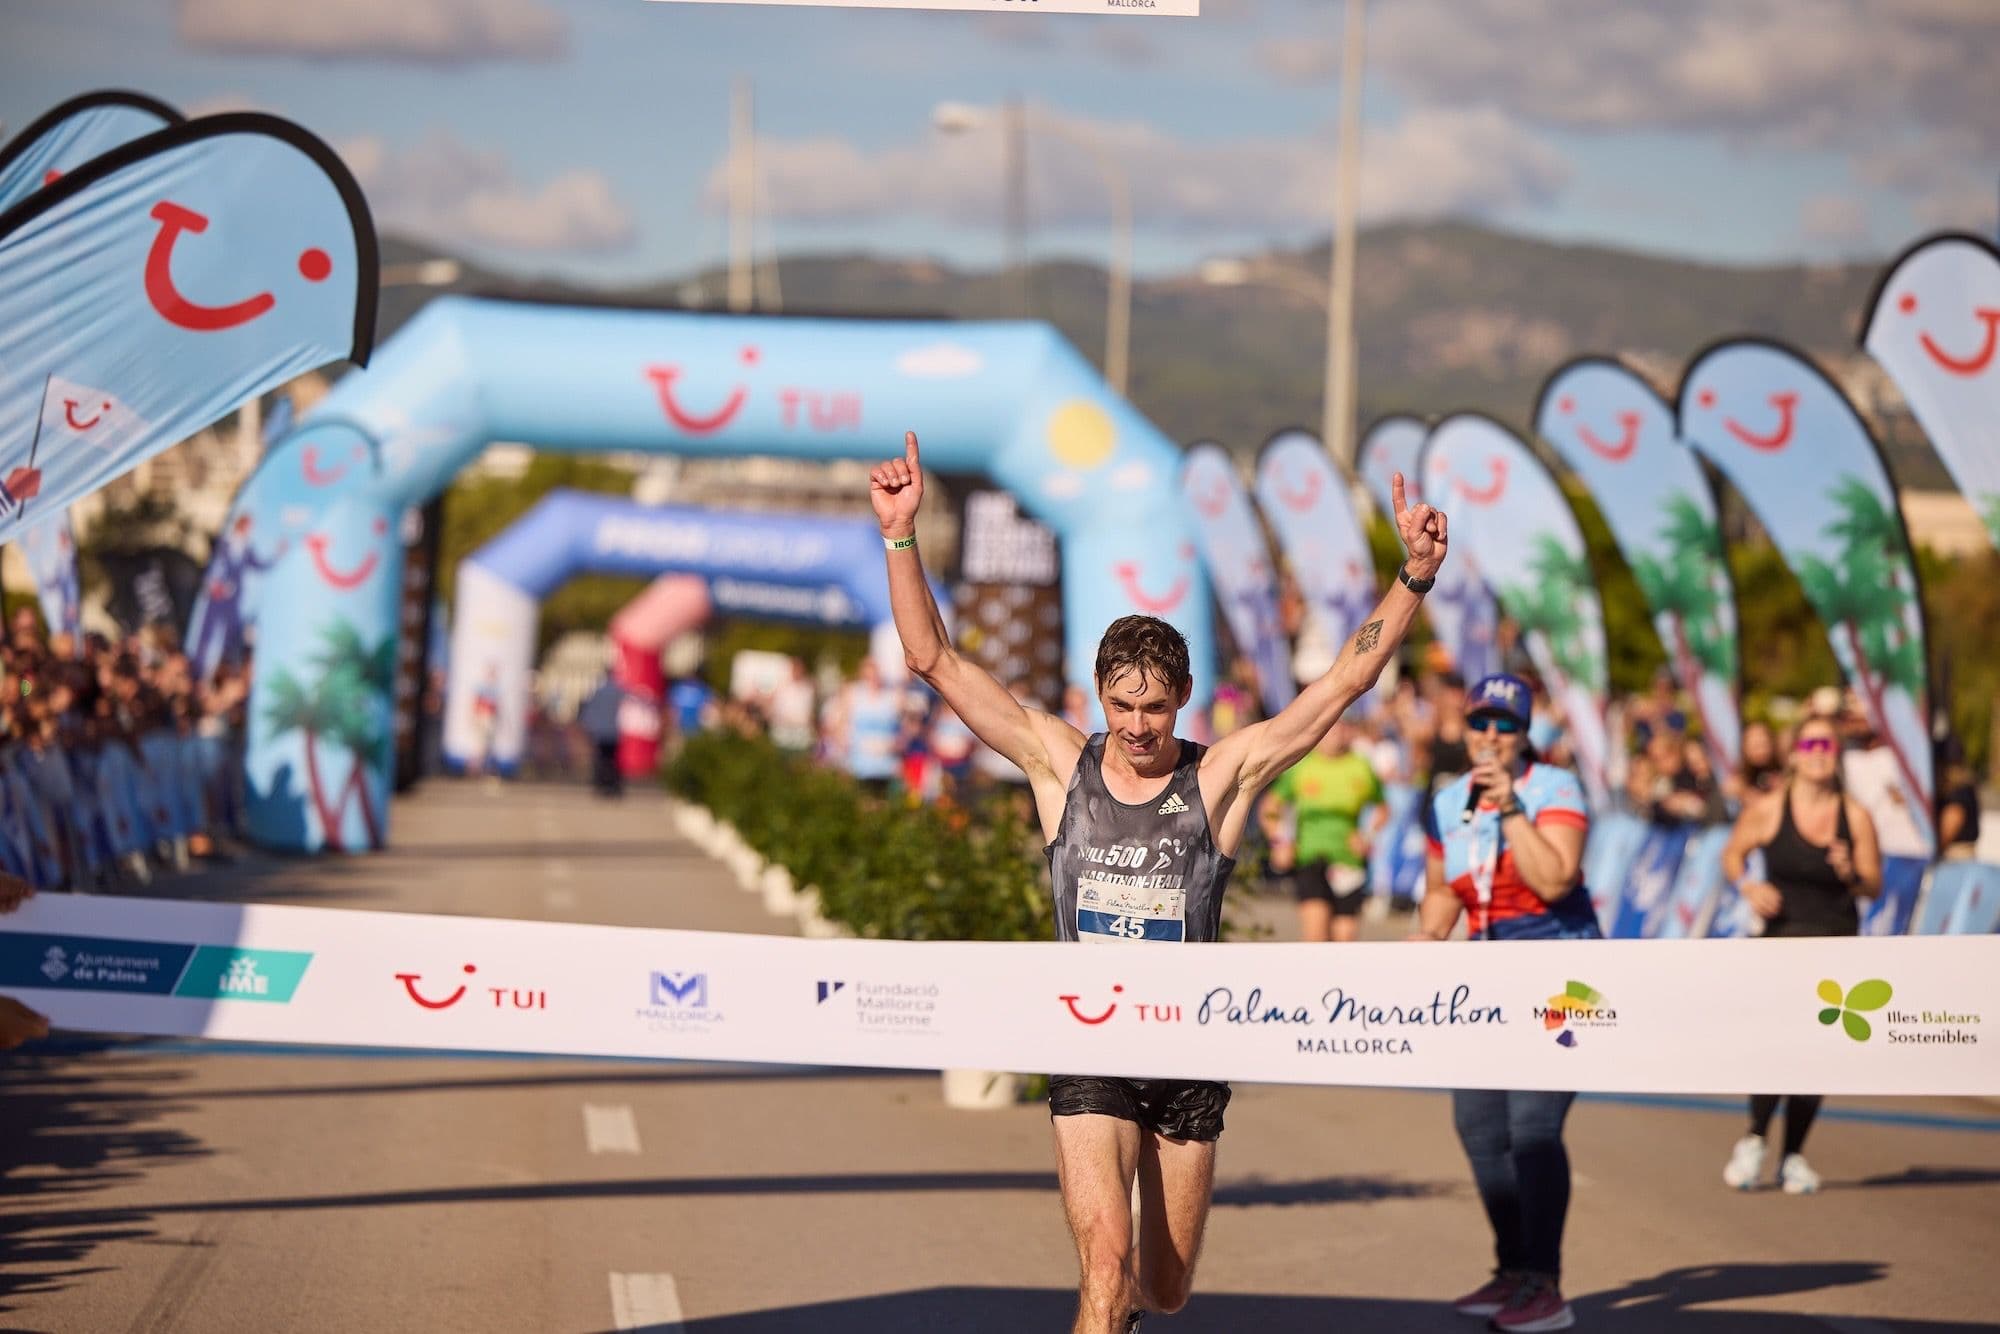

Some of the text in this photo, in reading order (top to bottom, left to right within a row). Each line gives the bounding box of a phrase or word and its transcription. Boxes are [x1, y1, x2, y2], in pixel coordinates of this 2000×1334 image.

[1107, 0, 1156, 8] MALLORCA
[1158, 804, 1190, 816] adidas
[1105, 845, 1148, 868] 500
[1109, 916, 1146, 939] 45
[74, 952, 160, 971] Ajuntament
[73, 967, 147, 983] de Palma
[856, 981, 940, 997] Fundació
[488, 987, 546, 1010] TUI
[856, 997, 936, 1012] Mallorca
[1134, 984, 1509, 1031] TUI Palma Marathon
[1532, 1006, 1617, 1020] Mallorca
[857, 1011, 932, 1026] Turisme
[1887, 1010, 1982, 1024] Illes Balears
[1887, 1028, 1978, 1044] Sostenibles
[1297, 1038, 1413, 1054] MALLORCA
